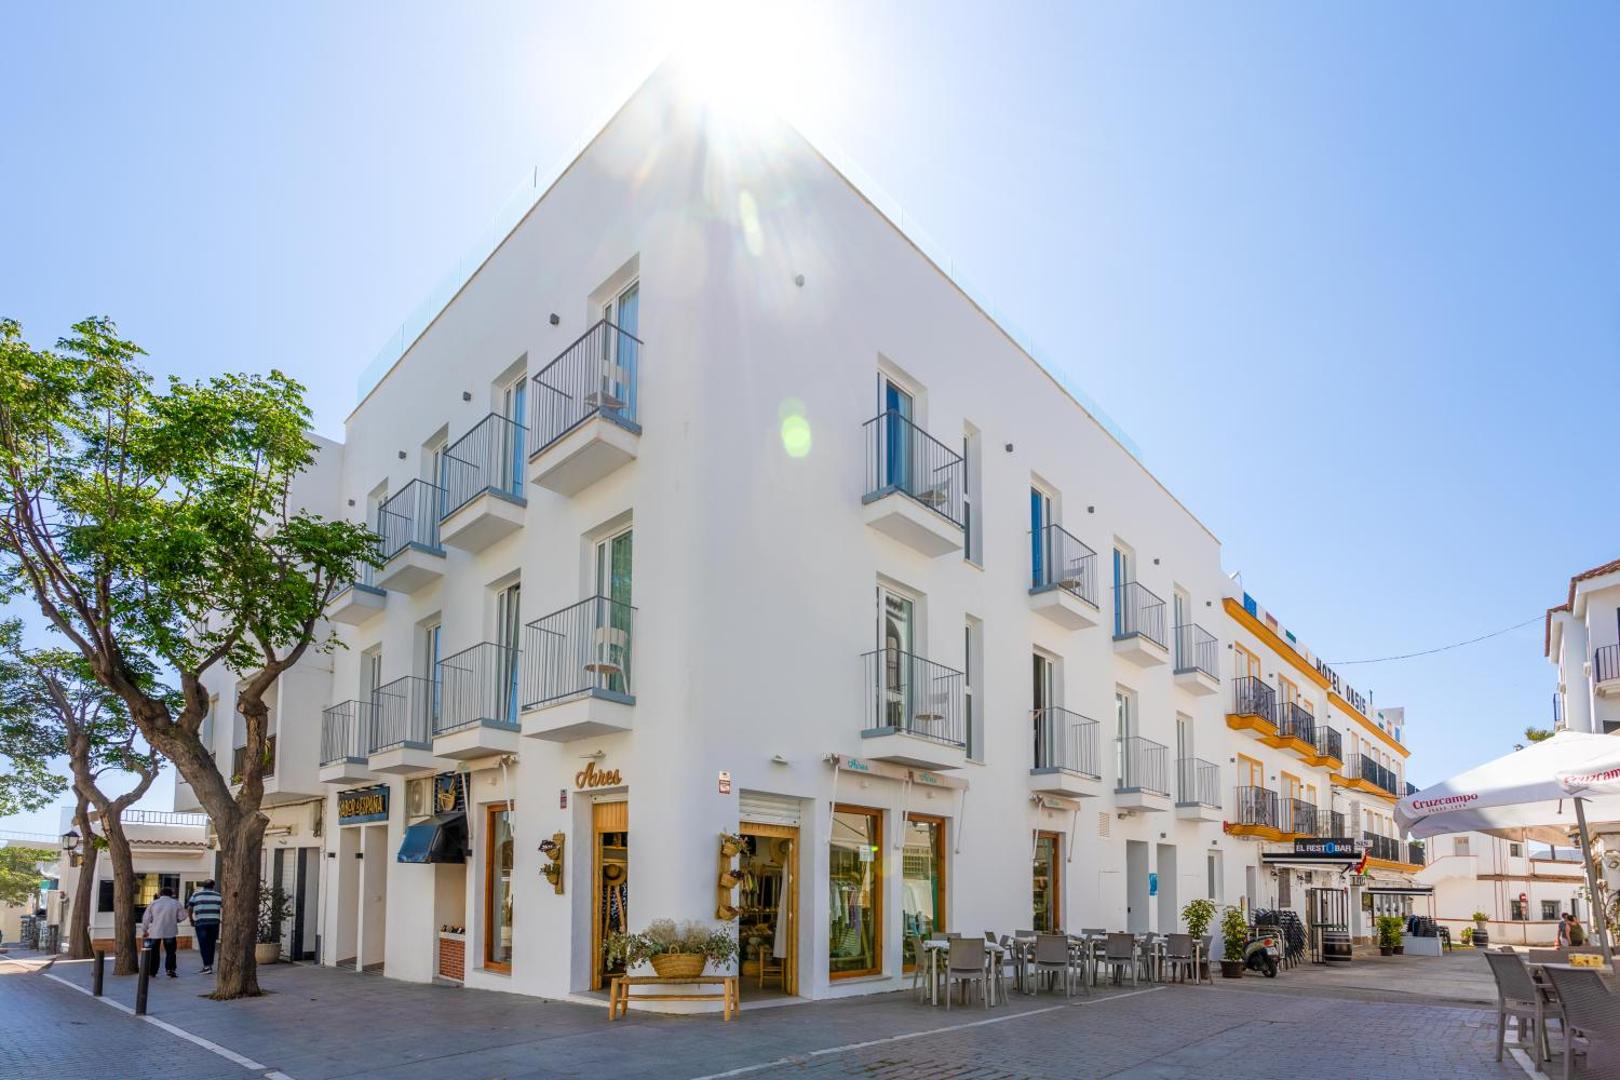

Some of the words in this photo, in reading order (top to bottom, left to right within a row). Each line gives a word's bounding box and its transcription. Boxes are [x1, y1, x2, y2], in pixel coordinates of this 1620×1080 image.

[1316, 657, 1341, 695] HOTEL
[1346, 684, 1366, 716] OASIS
[1412, 793, 1479, 810] Cruzcampo
[1295, 844, 1306, 852] EL
